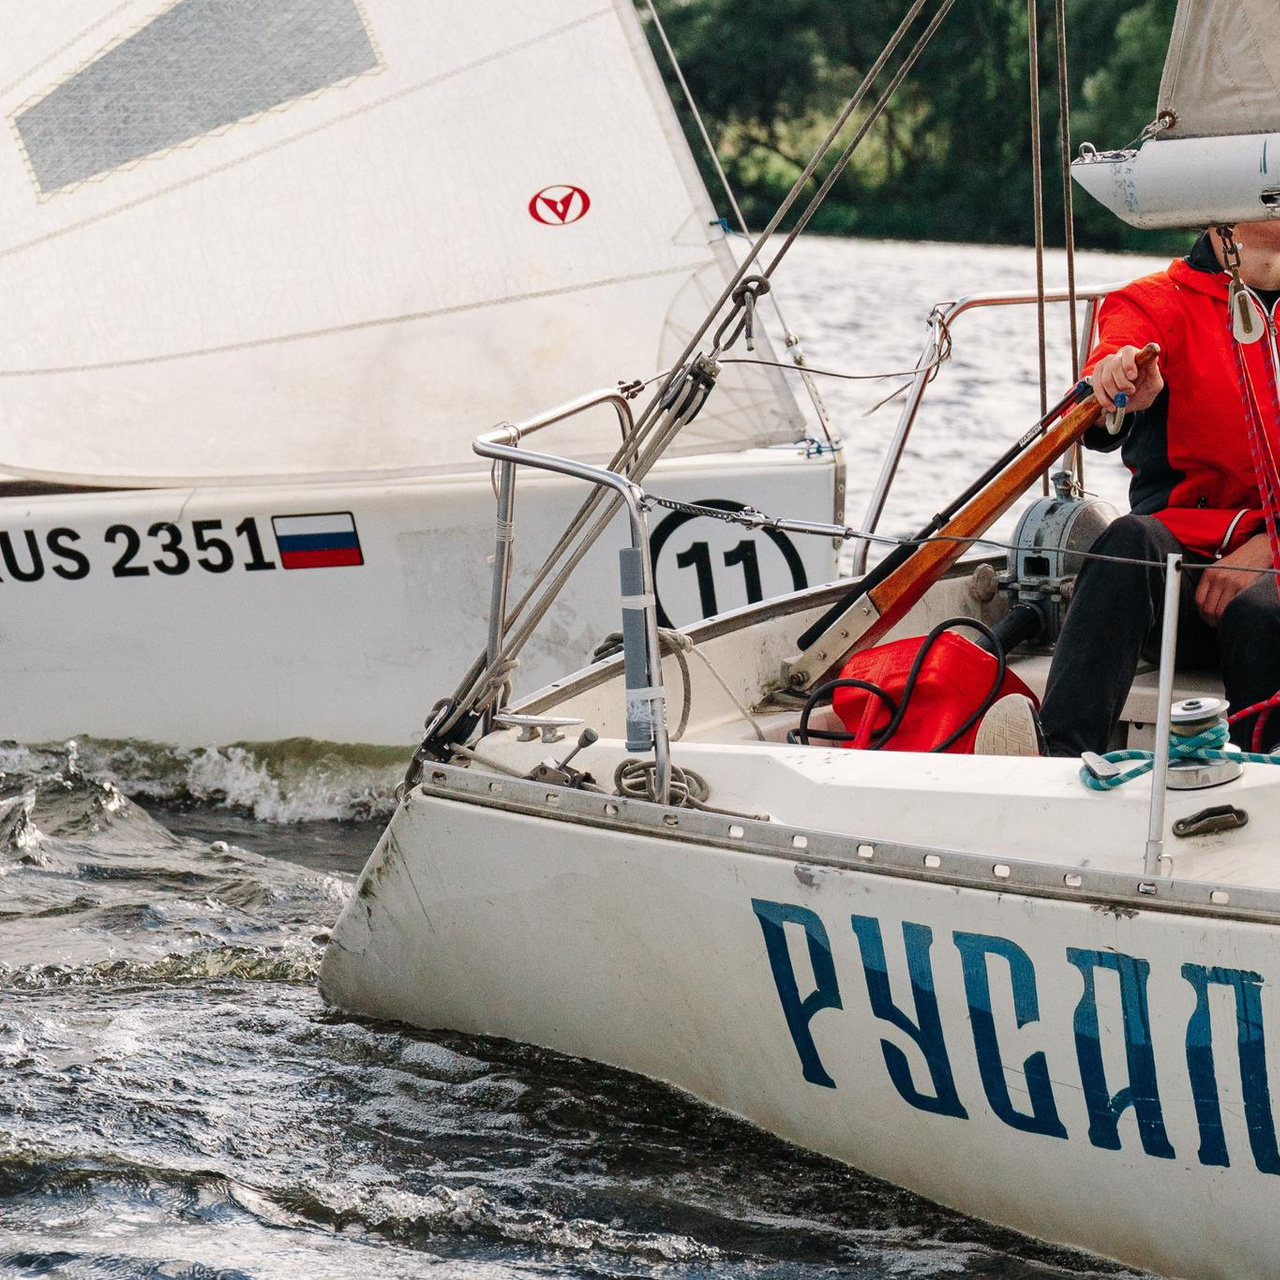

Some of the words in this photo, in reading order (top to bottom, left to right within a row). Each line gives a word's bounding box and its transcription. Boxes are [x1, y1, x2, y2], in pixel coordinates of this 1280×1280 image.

[0, 528, 90, 583] US
[104, 517, 276, 577] 2351
[676, 539, 764, 620] 11
